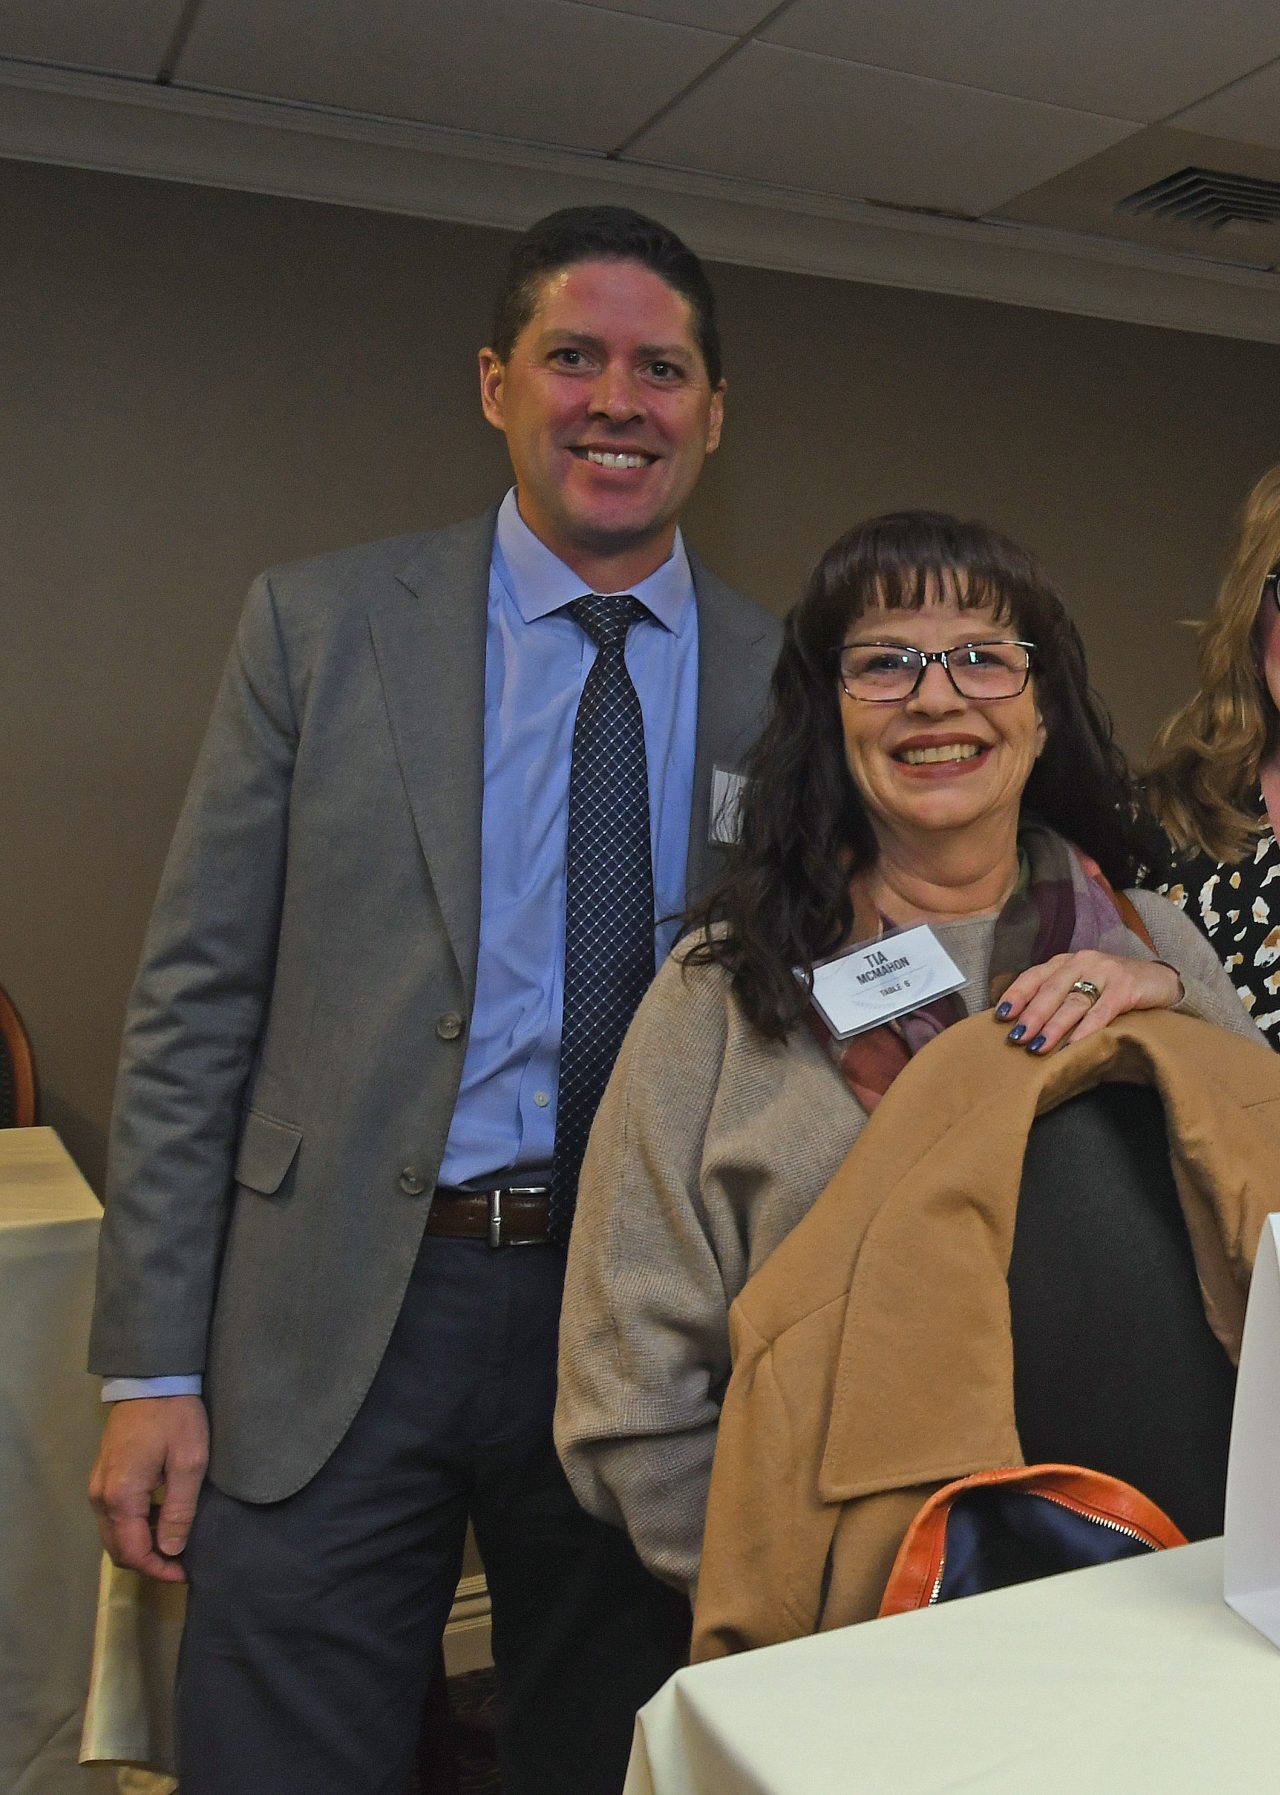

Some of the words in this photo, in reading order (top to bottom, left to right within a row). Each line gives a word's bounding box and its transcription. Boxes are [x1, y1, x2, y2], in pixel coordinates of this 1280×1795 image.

[863, 950, 889, 968] TIA
[856, 956, 910, 986] MCMAHON
[879, 983, 902, 997] TABLE
